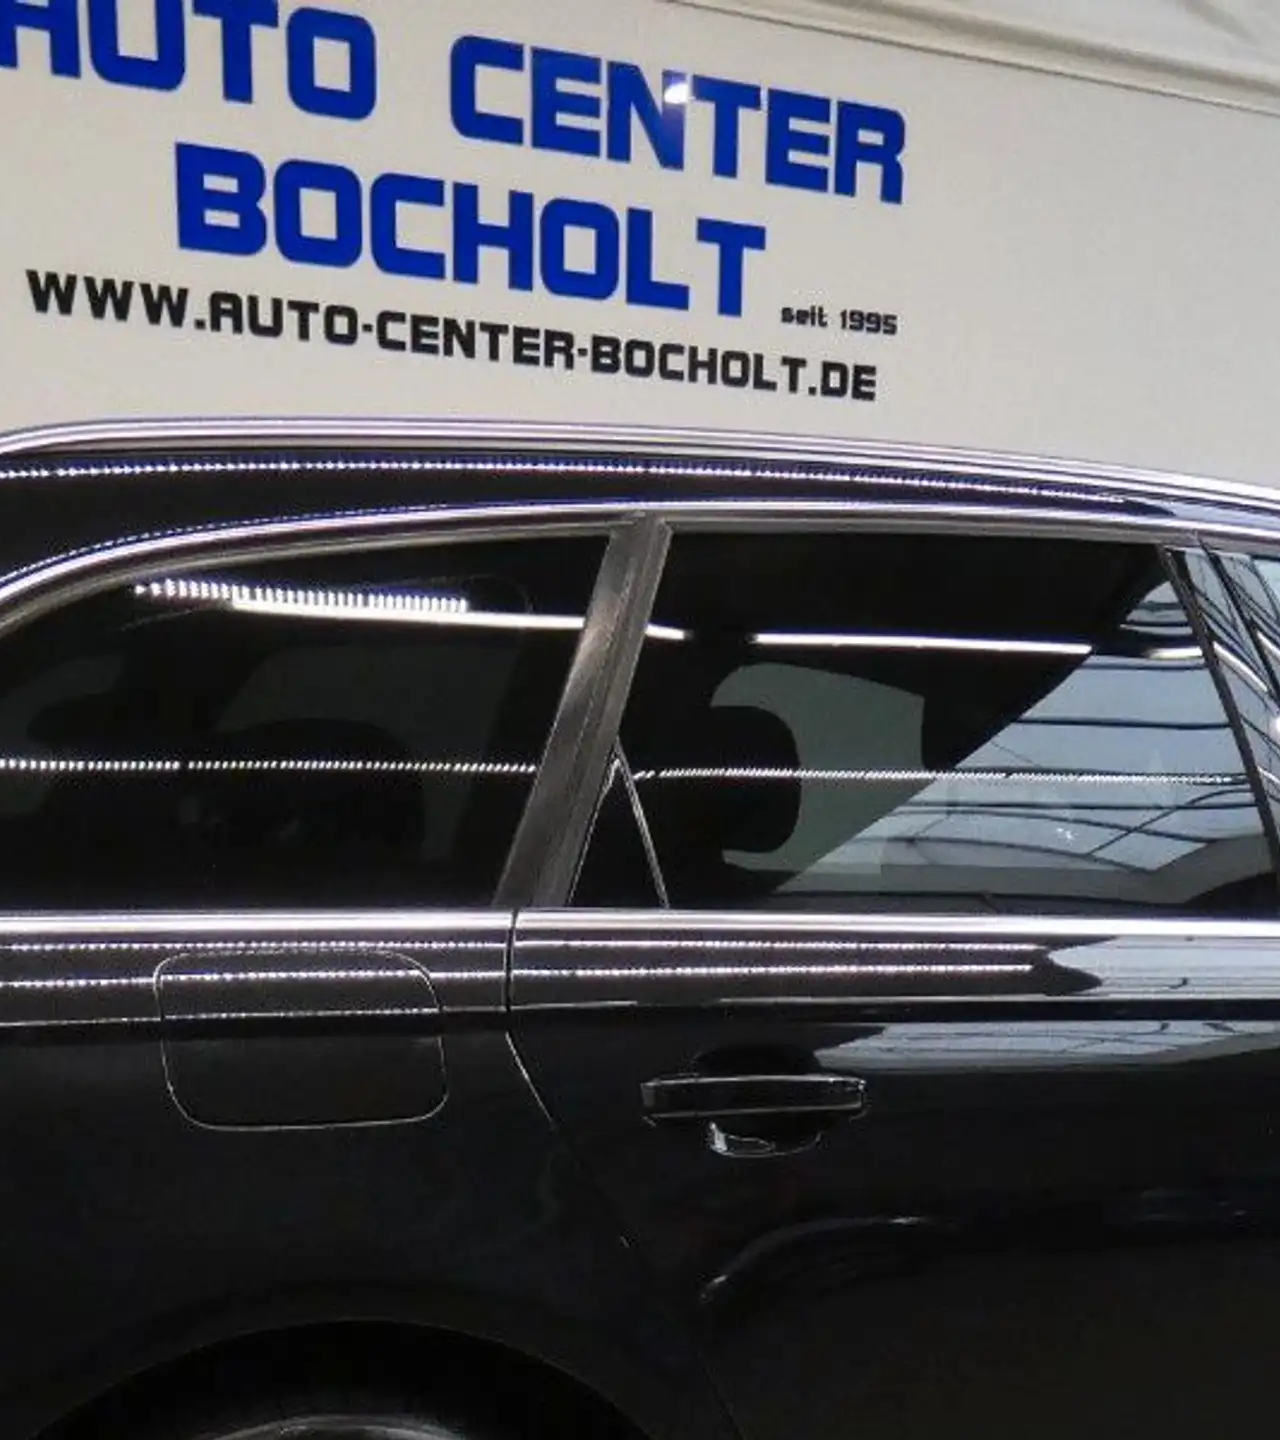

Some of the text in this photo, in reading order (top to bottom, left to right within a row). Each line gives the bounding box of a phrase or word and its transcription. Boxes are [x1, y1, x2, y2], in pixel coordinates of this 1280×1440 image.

[450, 37, 905, 205] CENTER
[175, 142, 768, 318] BOCHOLT
[25, 269, 877, 402] WWW.AUTO-CENTER-BOCHOLT.DE
[780, 305, 898, 335] seit 1995
